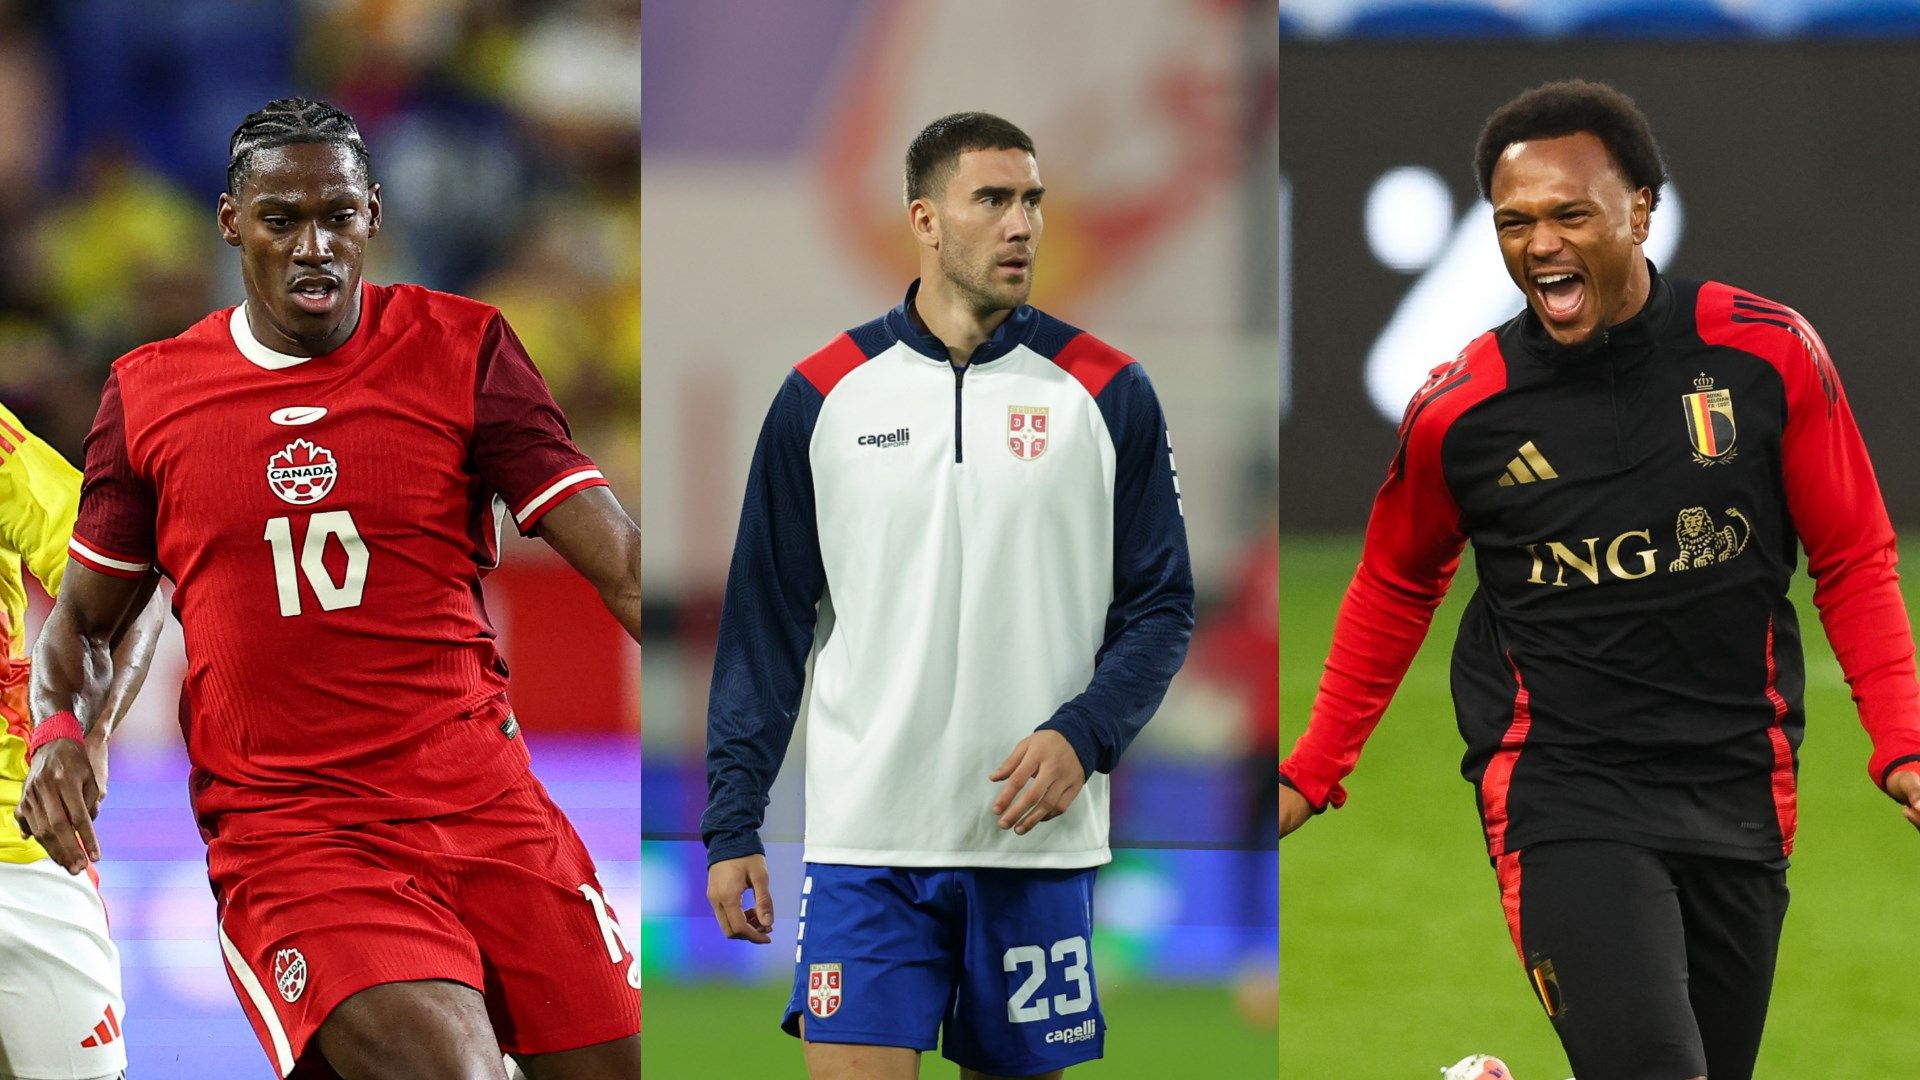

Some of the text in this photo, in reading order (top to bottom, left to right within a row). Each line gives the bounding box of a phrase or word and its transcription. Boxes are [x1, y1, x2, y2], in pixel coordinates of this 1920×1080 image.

[858, 428, 909, 447] capelli
[270, 465, 333, 480] CANADA
[264, 510, 370, 617] 10
[1521, 528, 1658, 587] ING
[1003, 935, 1092, 1023] 23
[1045, 1019, 1096, 1043] capelli
[1068, 1033, 1096, 1043] SPORT
